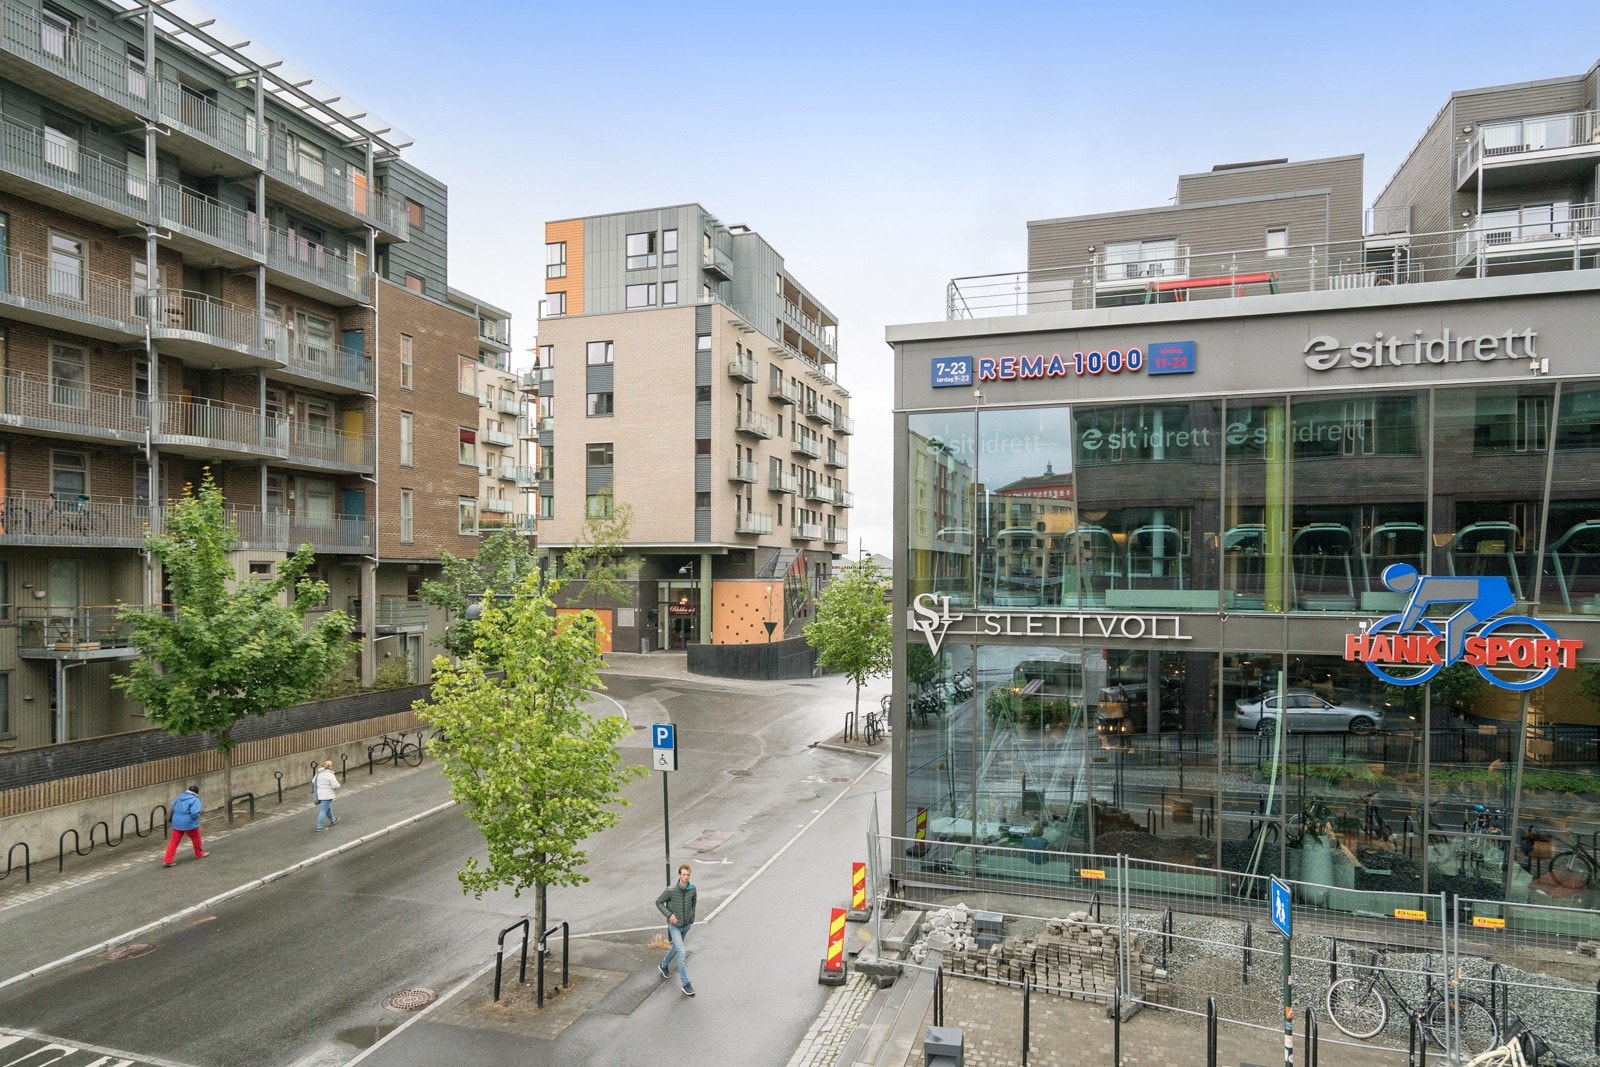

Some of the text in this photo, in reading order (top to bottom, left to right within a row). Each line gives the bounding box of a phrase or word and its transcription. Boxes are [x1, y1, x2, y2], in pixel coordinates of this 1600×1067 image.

[1350, 327, 1537, 369] sit idrett
[936, 361, 967, 375] 7-23
[978, 347, 1143, 381] REMA 1000
[1155, 356, 1188, 369] 11-22
[954, 374, 970, 382] 9-23
[1108, 426, 1210, 450] sit idrett
[1292, 420, 1365, 443] idrett
[981, 433, 1041, 454] idrett
[984, 613, 1192, 640] SLETTVOLL
[1344, 633, 1584, 669] HANK SPORT
[656, 727, 669, 746] P
